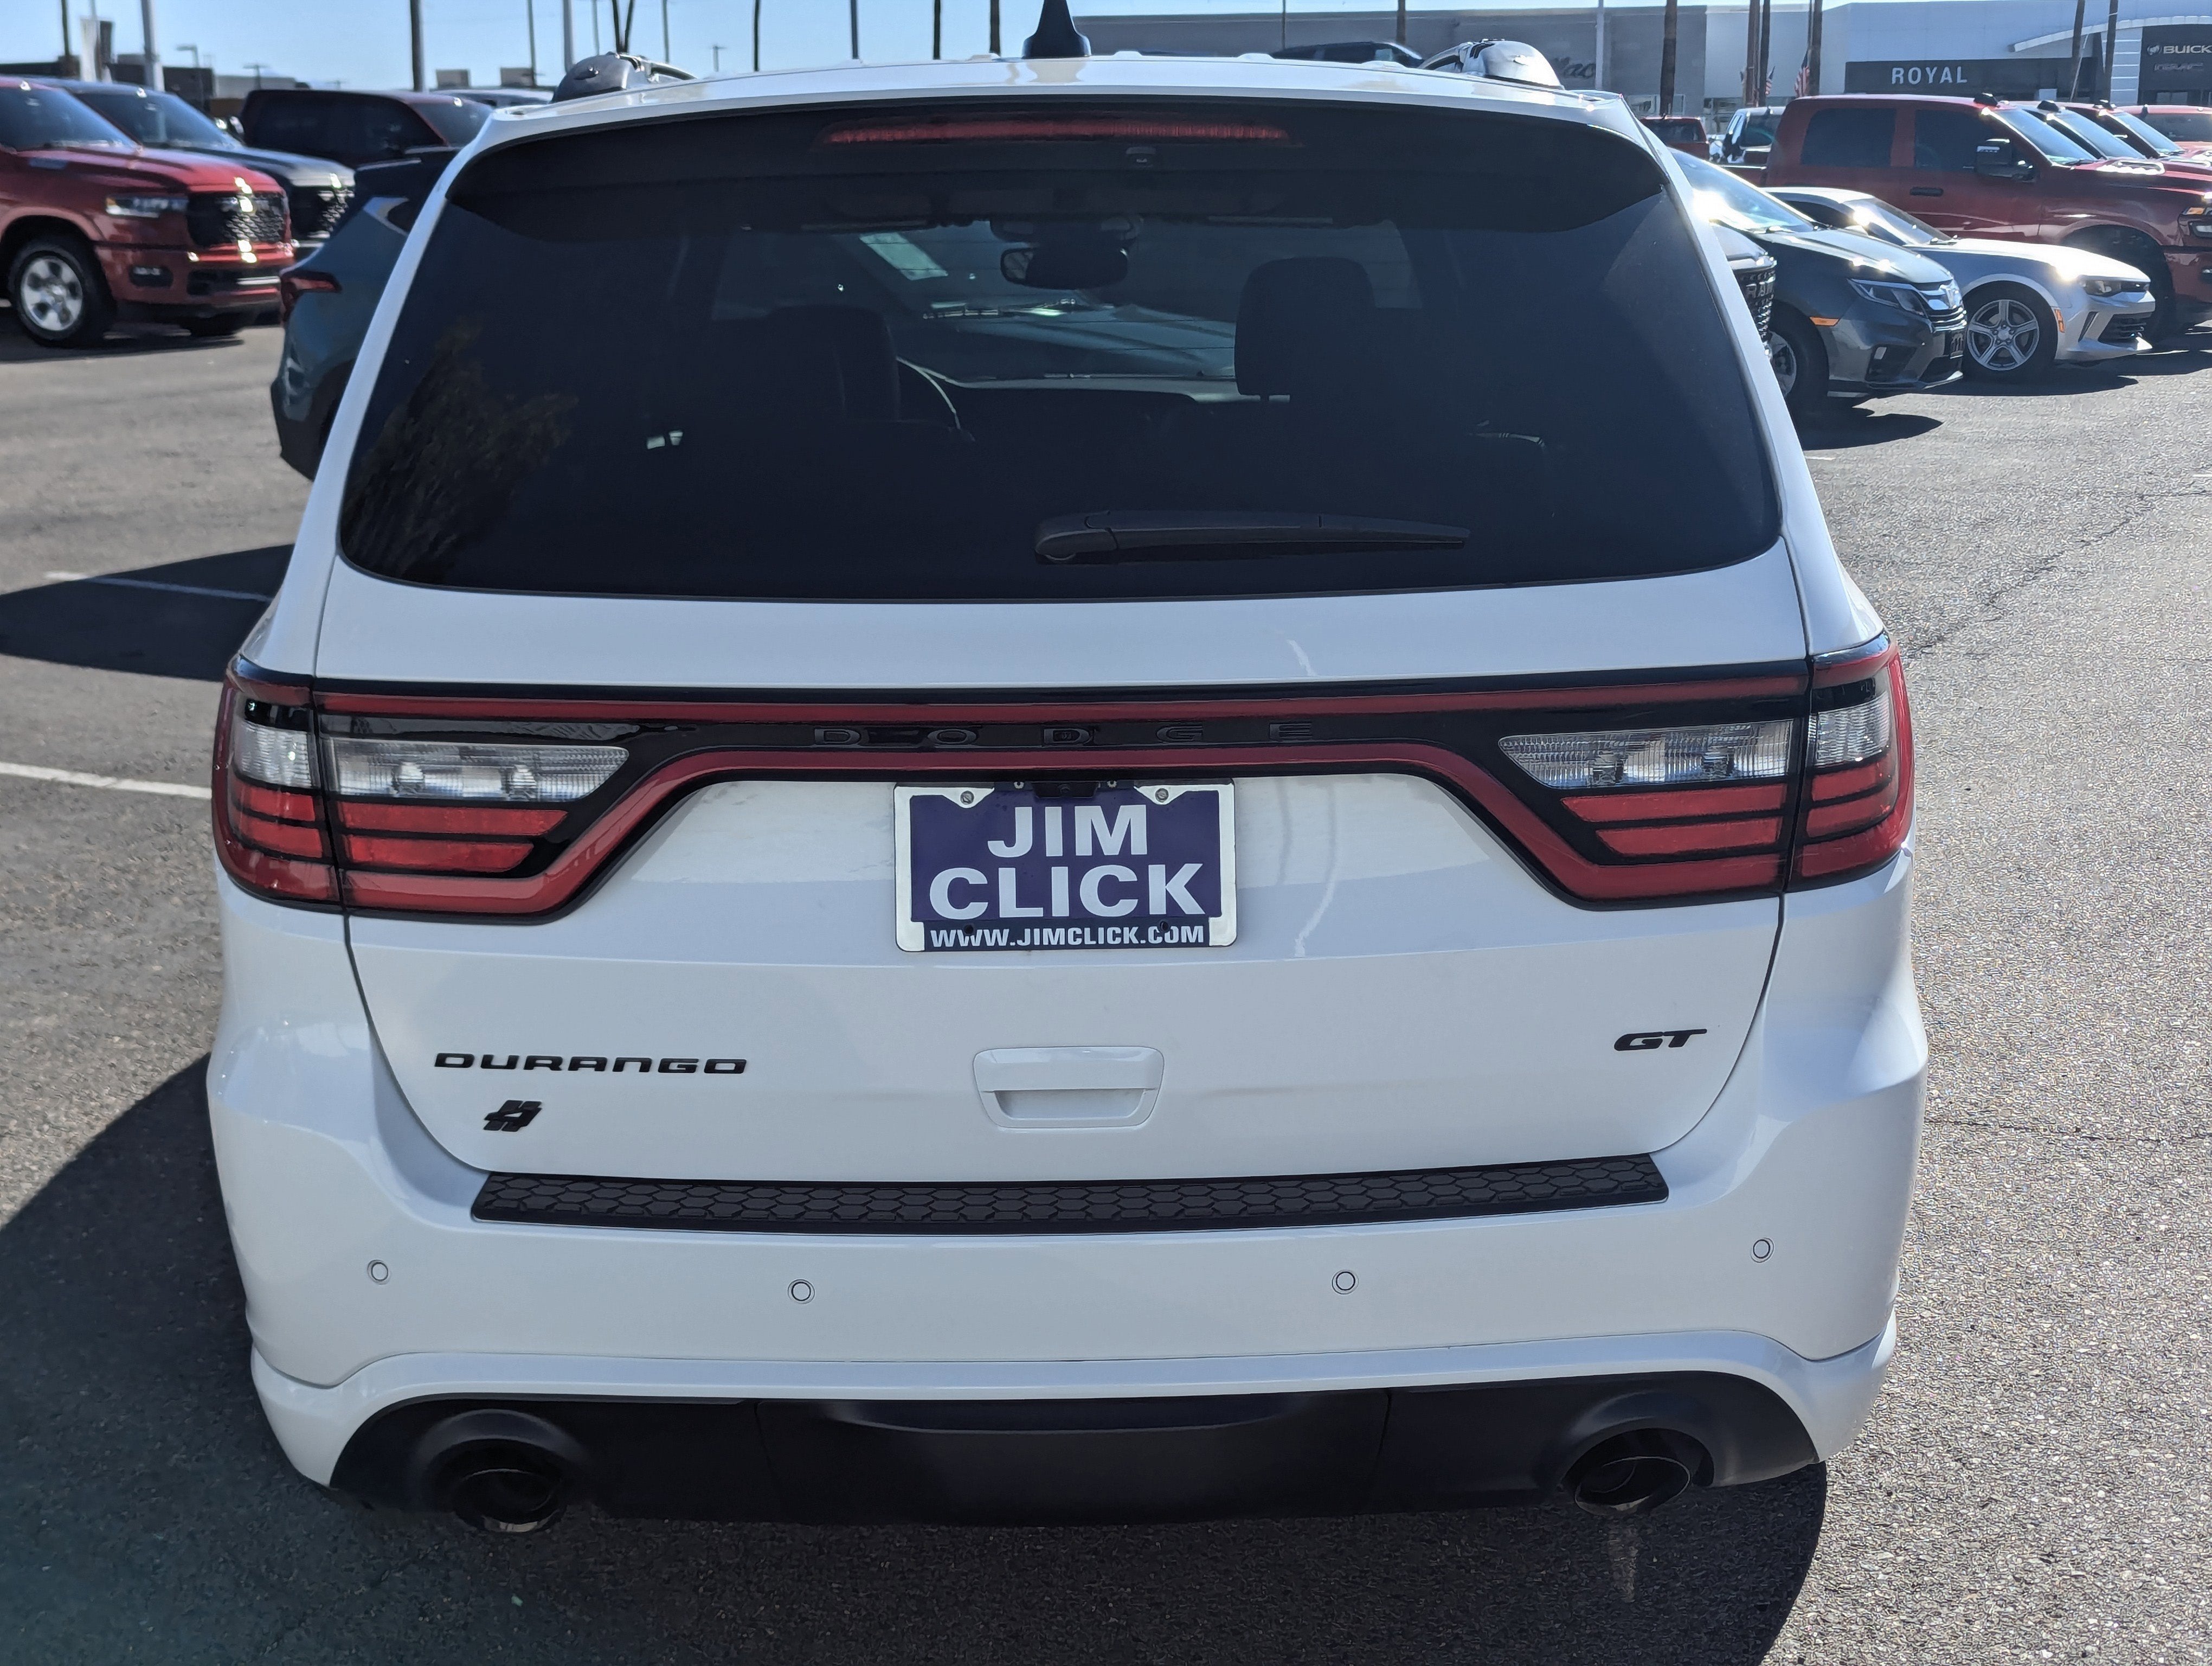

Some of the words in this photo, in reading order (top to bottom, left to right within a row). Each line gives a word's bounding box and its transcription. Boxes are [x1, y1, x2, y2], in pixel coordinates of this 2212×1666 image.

[2163, 45, 2212, 54] BUICK
[1892, 66, 1967, 85] ROYAL
[814, 722, 1312, 745] DODGE
[987, 804, 1147, 857] JIM
[929, 863, 1205, 920] CLICK
[930, 925, 1204, 947] WWW.JIMCLICK.COM
[1614, 1029, 1707, 1052] GT
[434, 1052, 747, 1074] DURANGO
